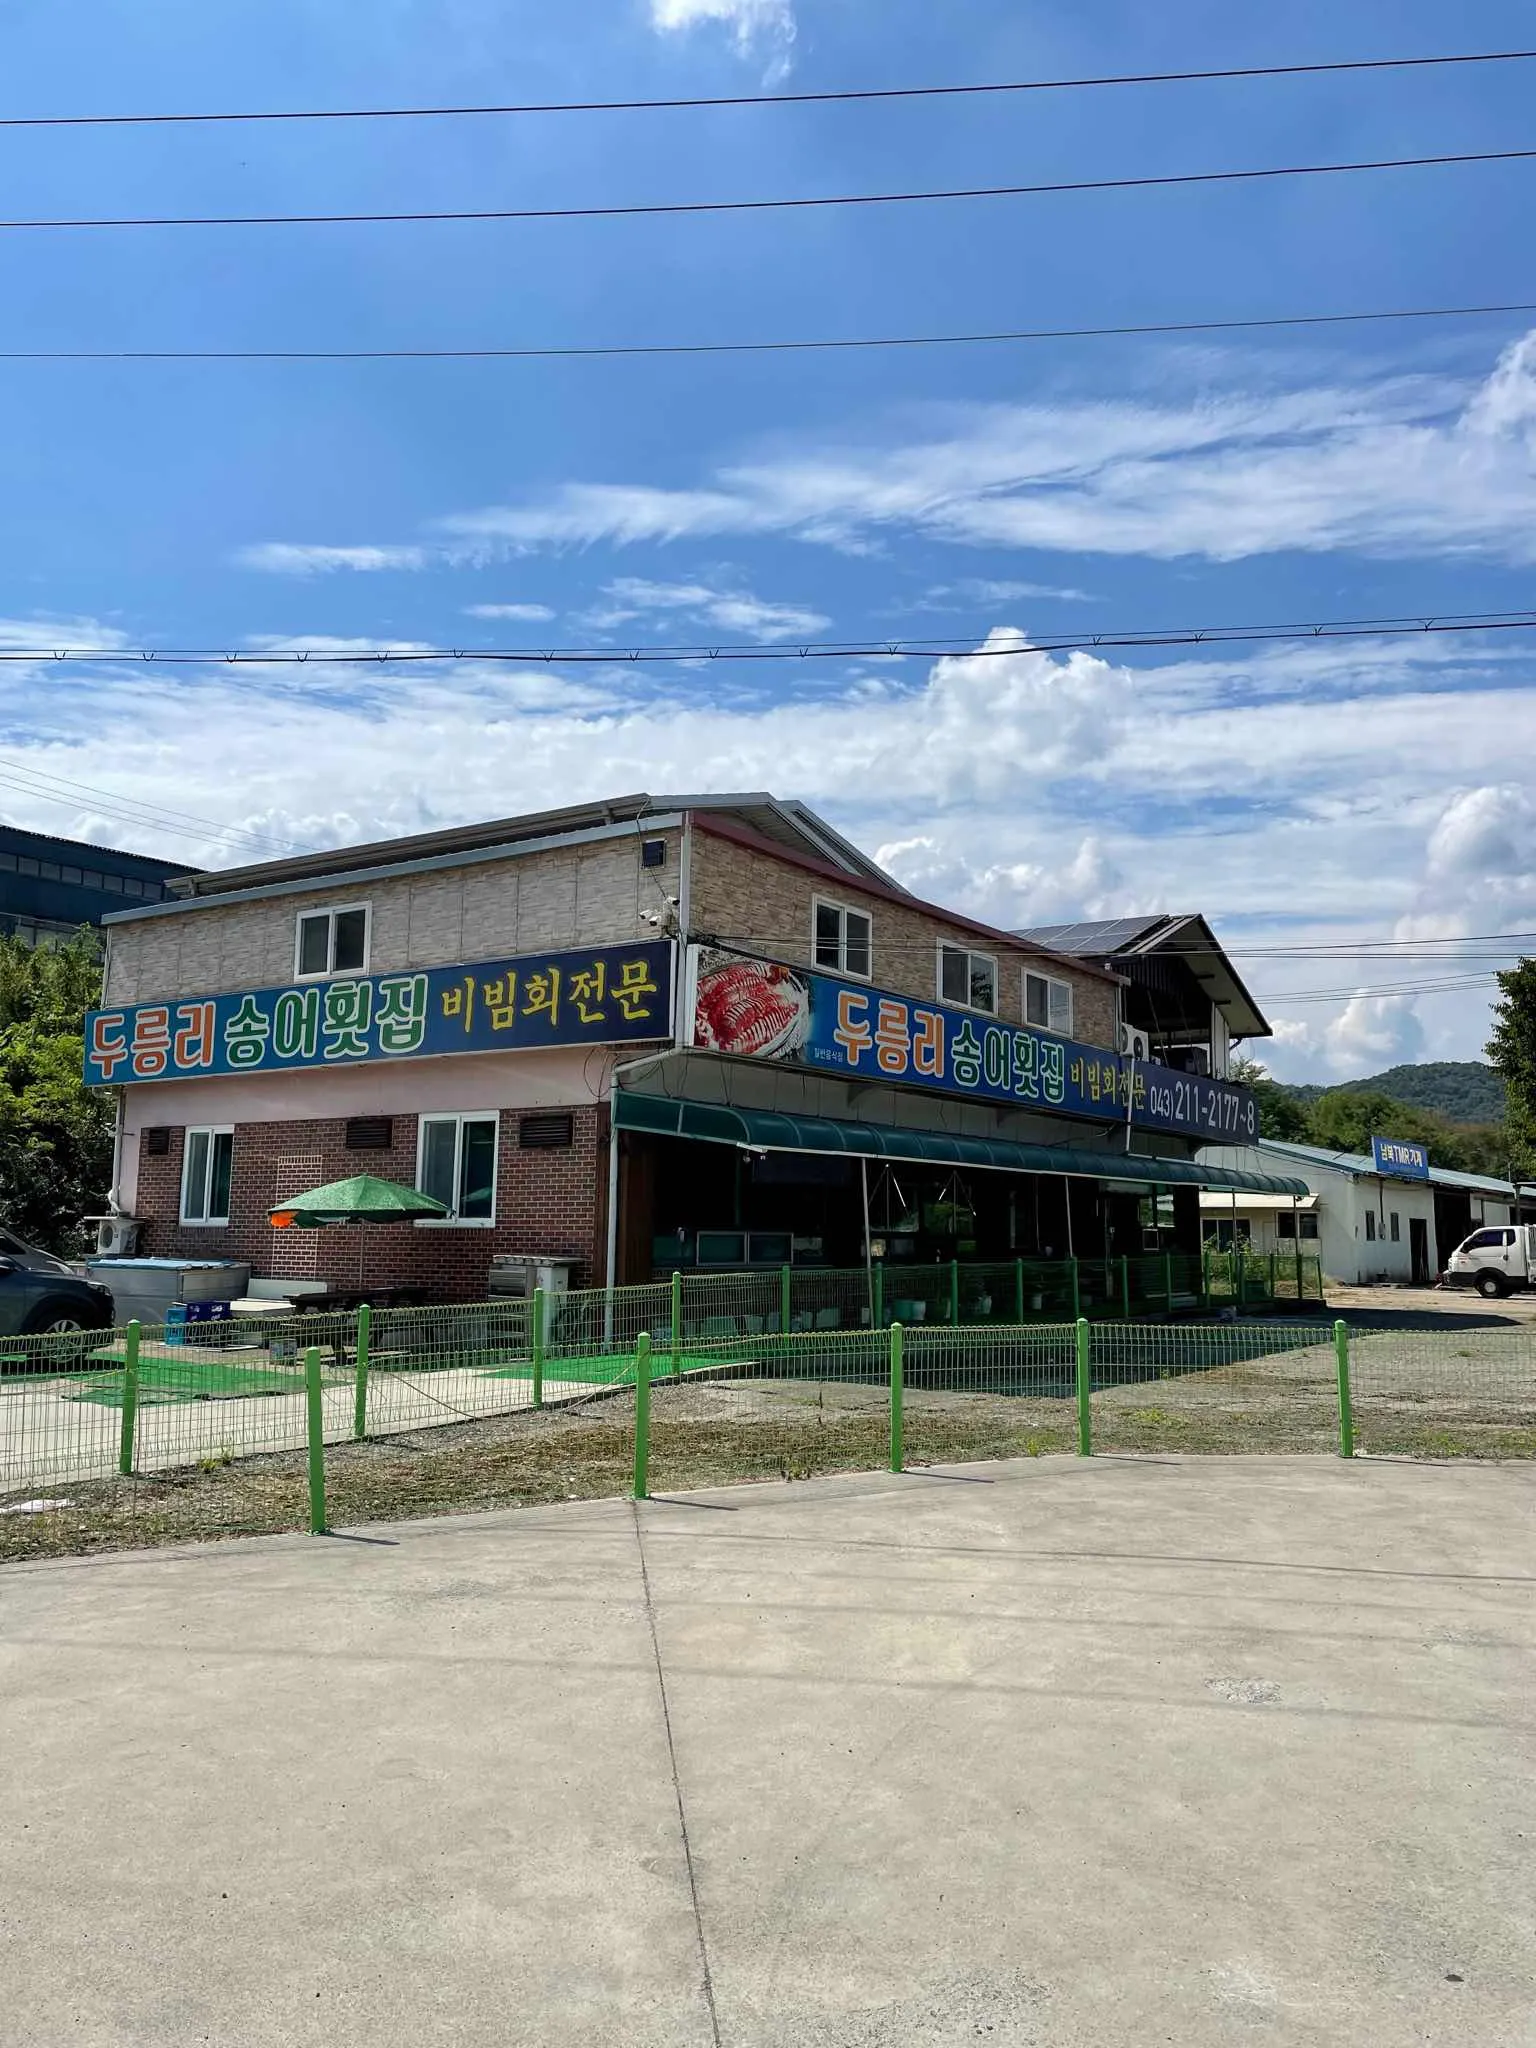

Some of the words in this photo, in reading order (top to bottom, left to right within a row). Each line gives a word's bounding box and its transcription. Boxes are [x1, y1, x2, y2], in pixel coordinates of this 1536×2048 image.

[89, 1002, 216, 1079] 두릉리
[224, 973, 429, 1068] 송어횟집
[834, 990, 945, 1078] 두릉리
[951, 1018, 1066, 1104] 송어횟집
